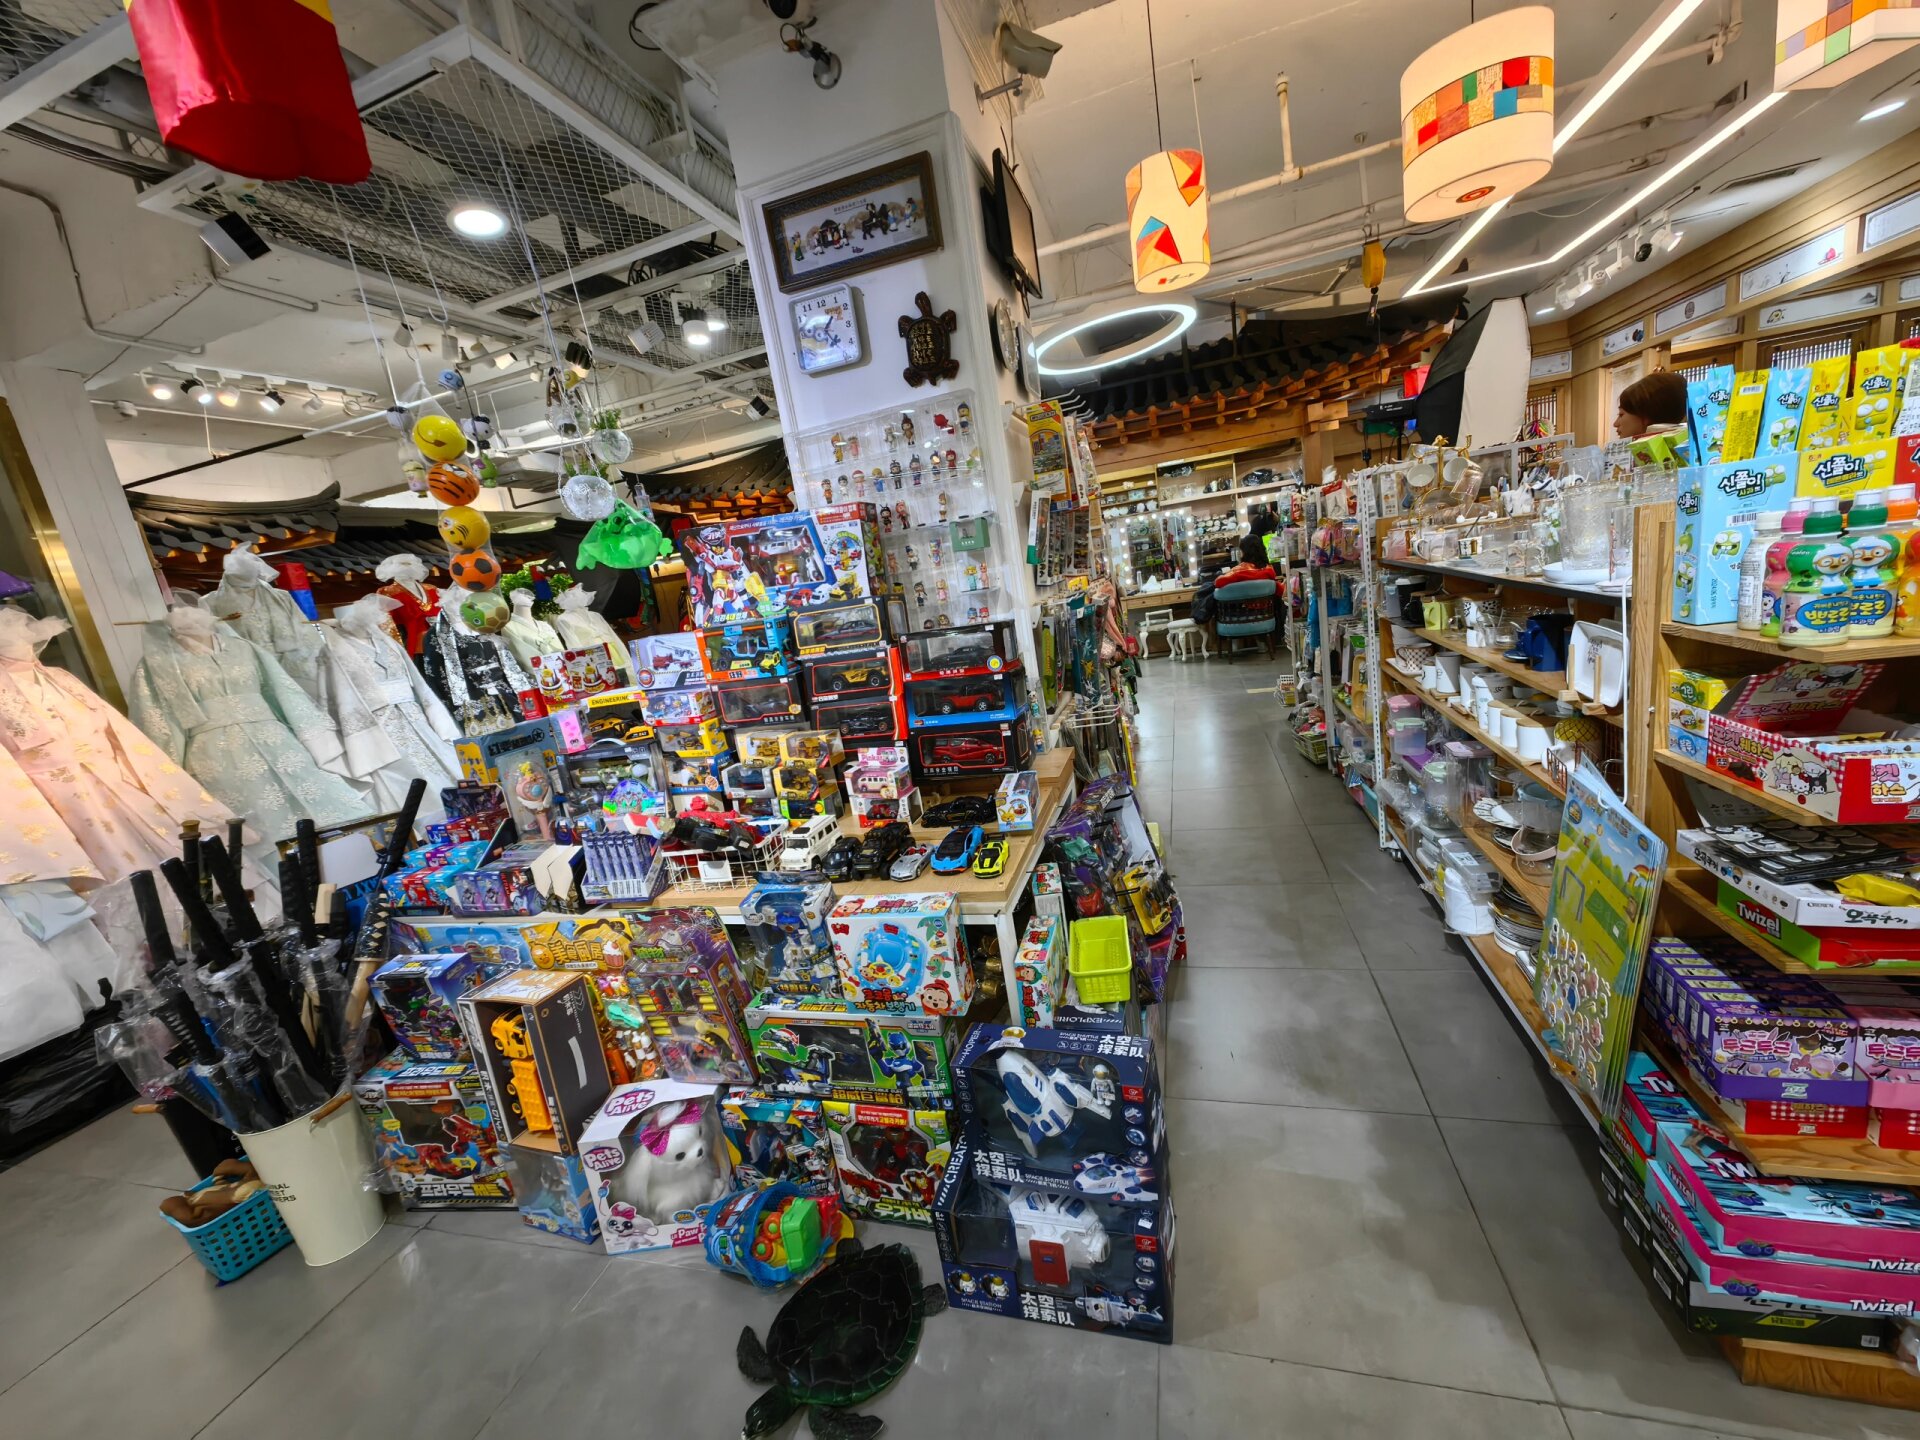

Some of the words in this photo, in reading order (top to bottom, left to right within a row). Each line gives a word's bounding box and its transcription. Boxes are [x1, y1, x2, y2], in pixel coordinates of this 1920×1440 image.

[803, 304, 812, 313] 11
[817, 300, 826, 309] 12
[1814, 455, 1863, 479] 신쫄이
[1719, 470, 1762, 492] 신쫄이
[1737, 902, 1781, 935] Twizel
[1101, 1034, 1132, 1047] 太空
[1097, 1044, 1145, 1059] 探索队
[608, 1090, 655, 1114] Pets
[612, 1101, 649, 1117] Alive
[584, 1148, 622, 1164] Pets
[593, 1158, 623, 1171] Alive
[944, 1134, 968, 1184] CREATO
[973, 1149, 1006, 1167] 太空
[976, 1162, 1026, 1184] 探索队
[677, 1226, 699, 1240] Paw
[1020, 1291, 1055, 1307] 太空
[1023, 1305, 1075, 1327] 探索队
[1851, 1299, 1914, 1317] Twizel
